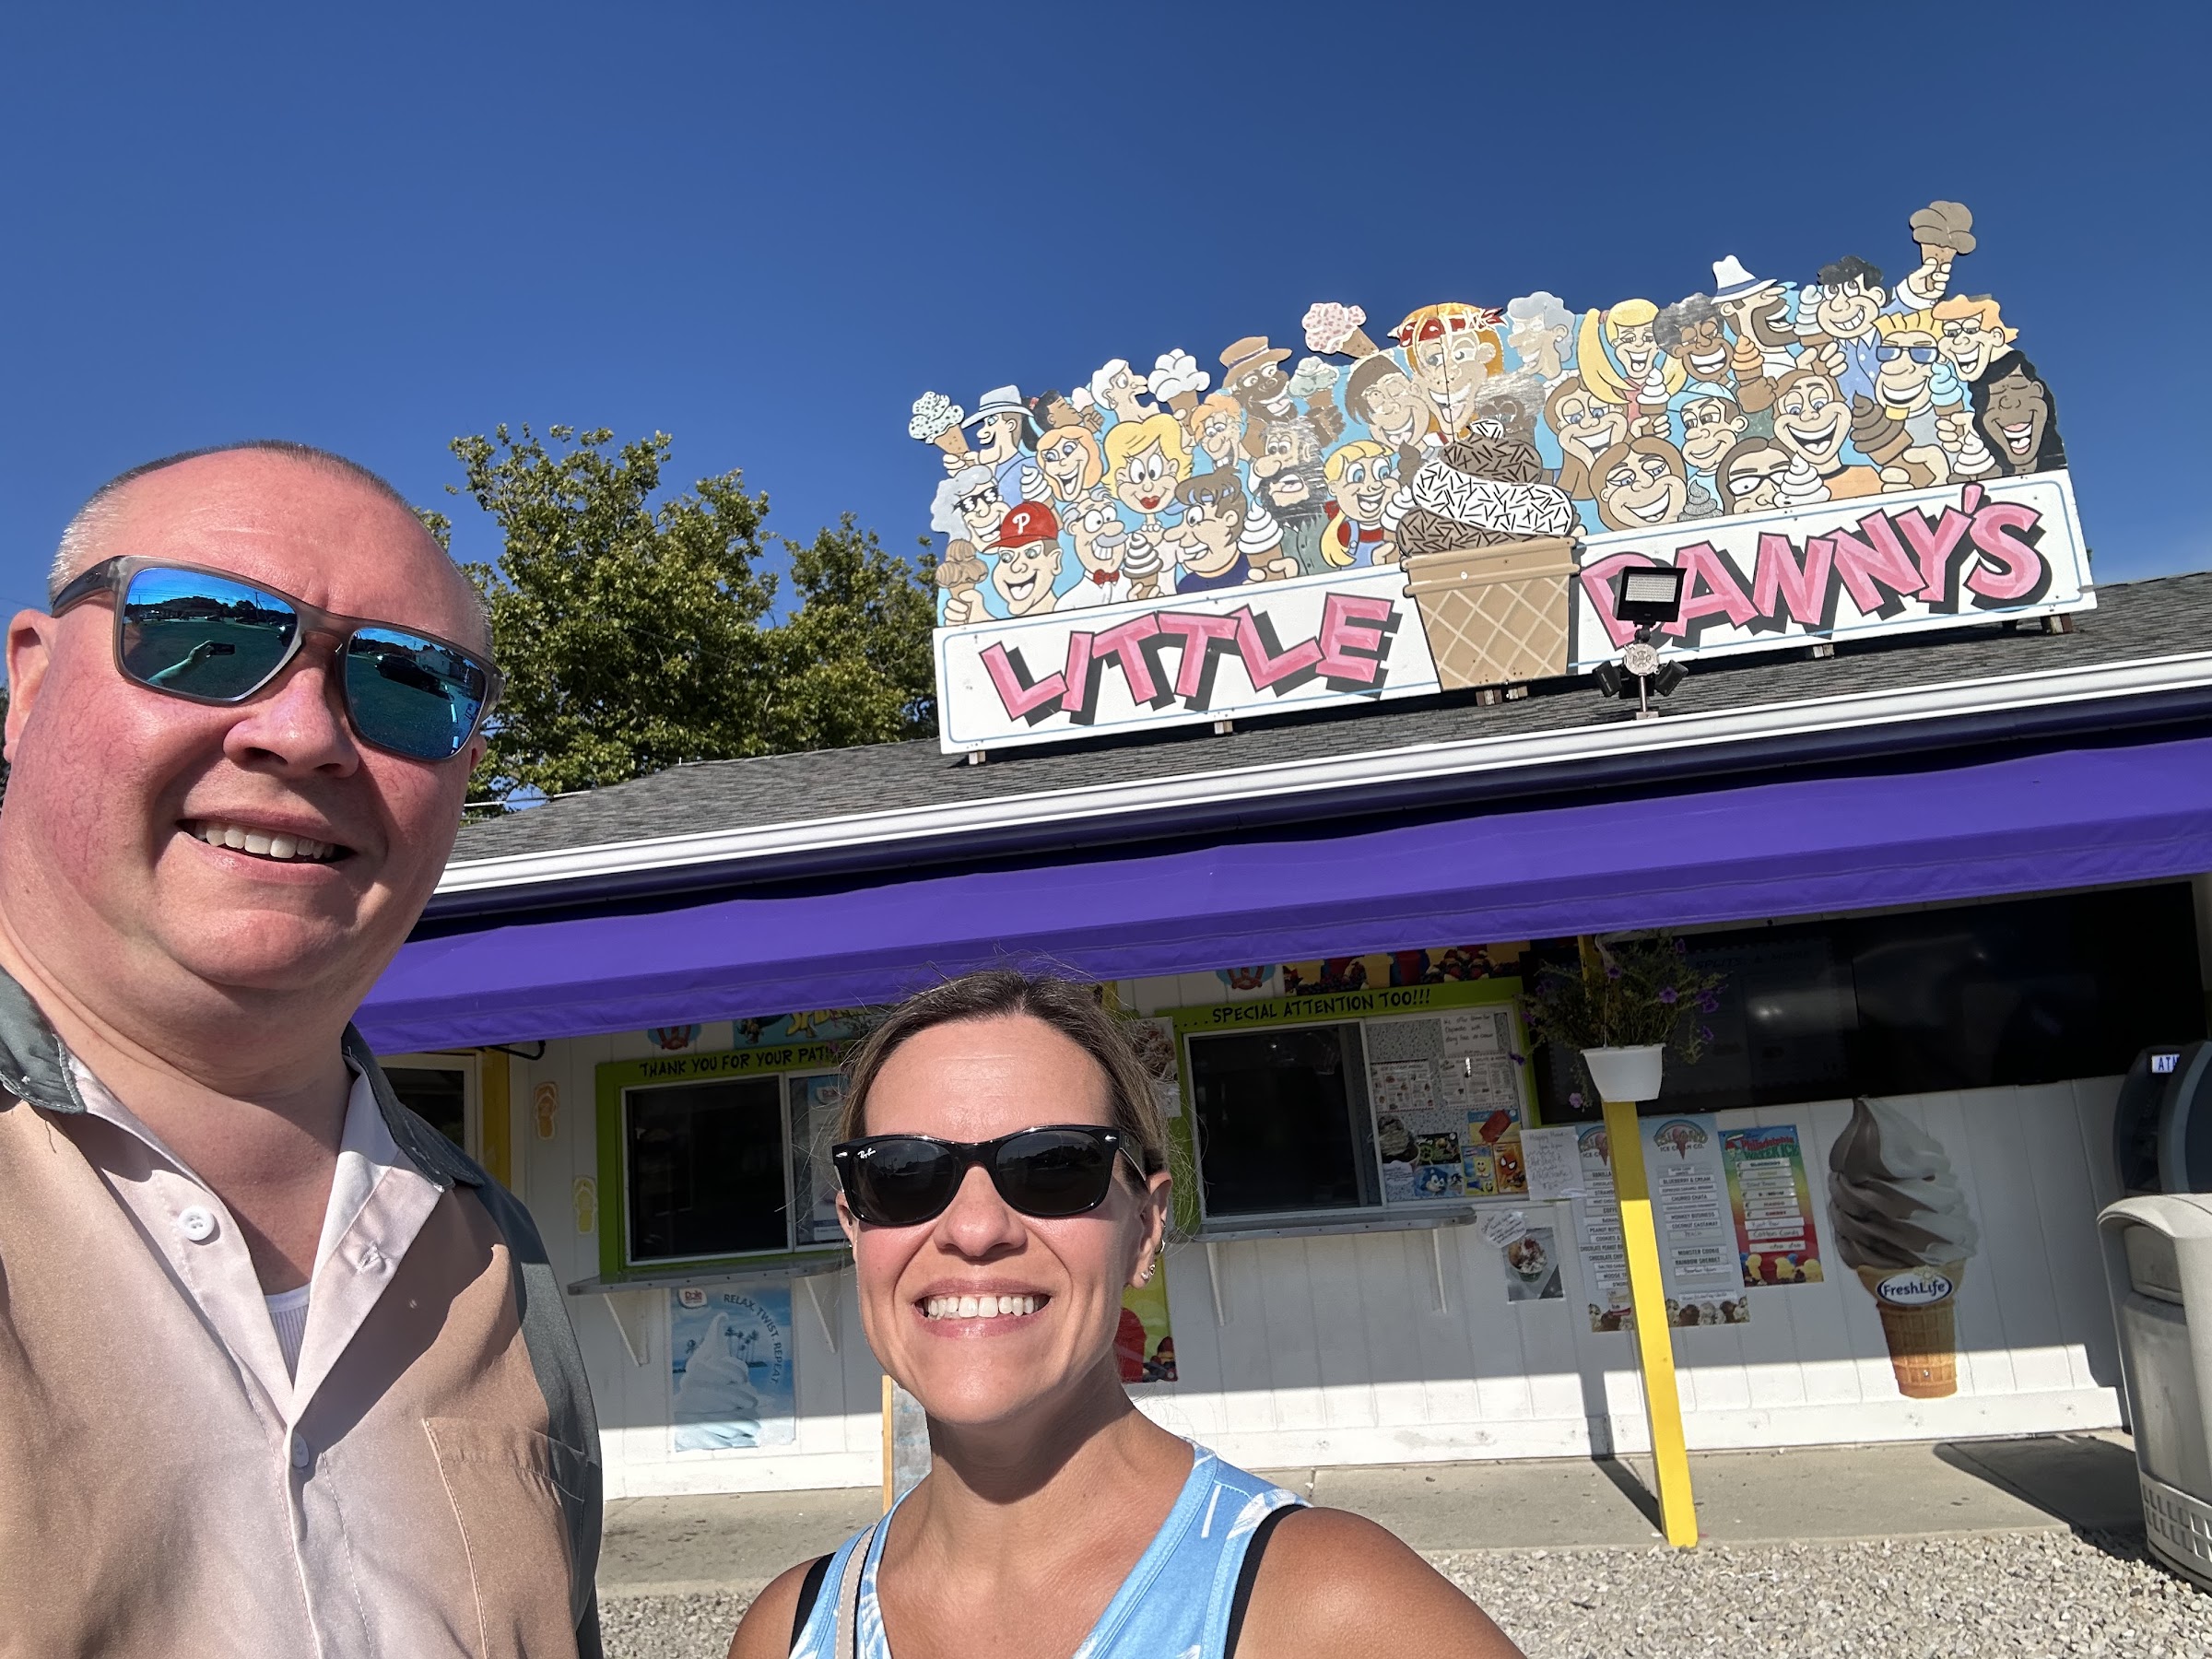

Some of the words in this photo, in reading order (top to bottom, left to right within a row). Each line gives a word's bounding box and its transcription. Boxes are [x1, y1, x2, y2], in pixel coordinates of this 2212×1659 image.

[1012, 512, 1030, 535] P
[978, 592, 1401, 726] LITTLE
[1581, 482, 2052, 651] DANNY'S
[1212, 1003, 1277, 1023] SPECIAL
[1283, 994, 1375, 1018] ATTENTION
[1379, 988, 1430, 1007] TOO!!!
[639, 1060, 687, 1077] THANK
[691, 1055, 718, 1073] YOU
[722, 1053, 750, 1070] FOR
[756, 1049, 793, 1067] YOUR
[1883, 1278, 1946, 1297] FreshLife
